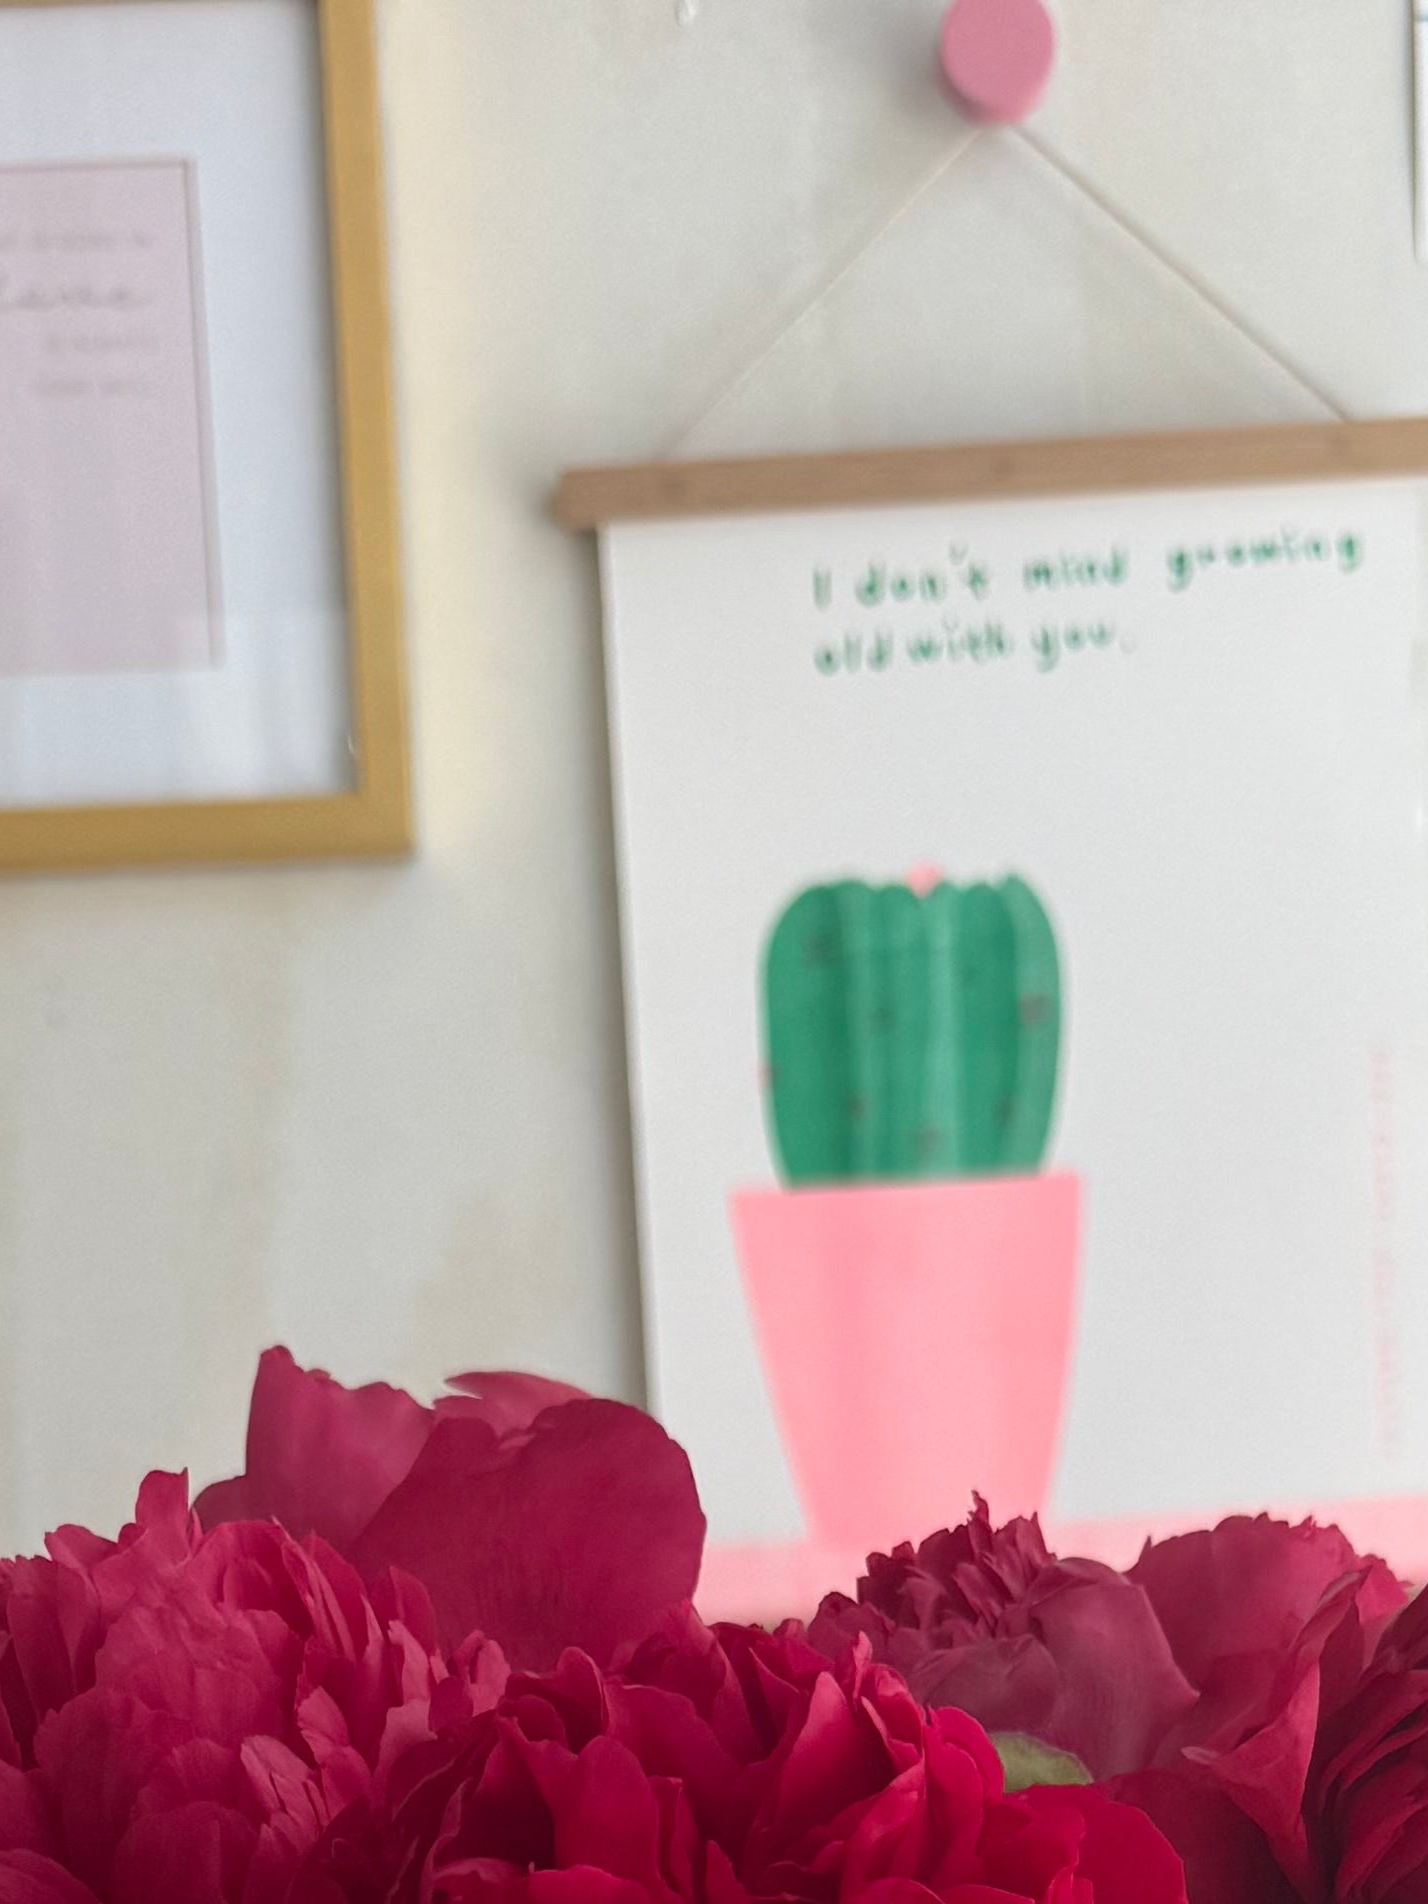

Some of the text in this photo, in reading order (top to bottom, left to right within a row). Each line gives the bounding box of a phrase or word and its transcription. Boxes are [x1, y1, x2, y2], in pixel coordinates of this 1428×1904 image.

[855, 540, 988, 608] don't
[1023, 545, 1129, 590] mind
[1168, 523, 1365, 592] growing
[814, 630, 893, 676] old
[907, 614, 1011, 663] with
